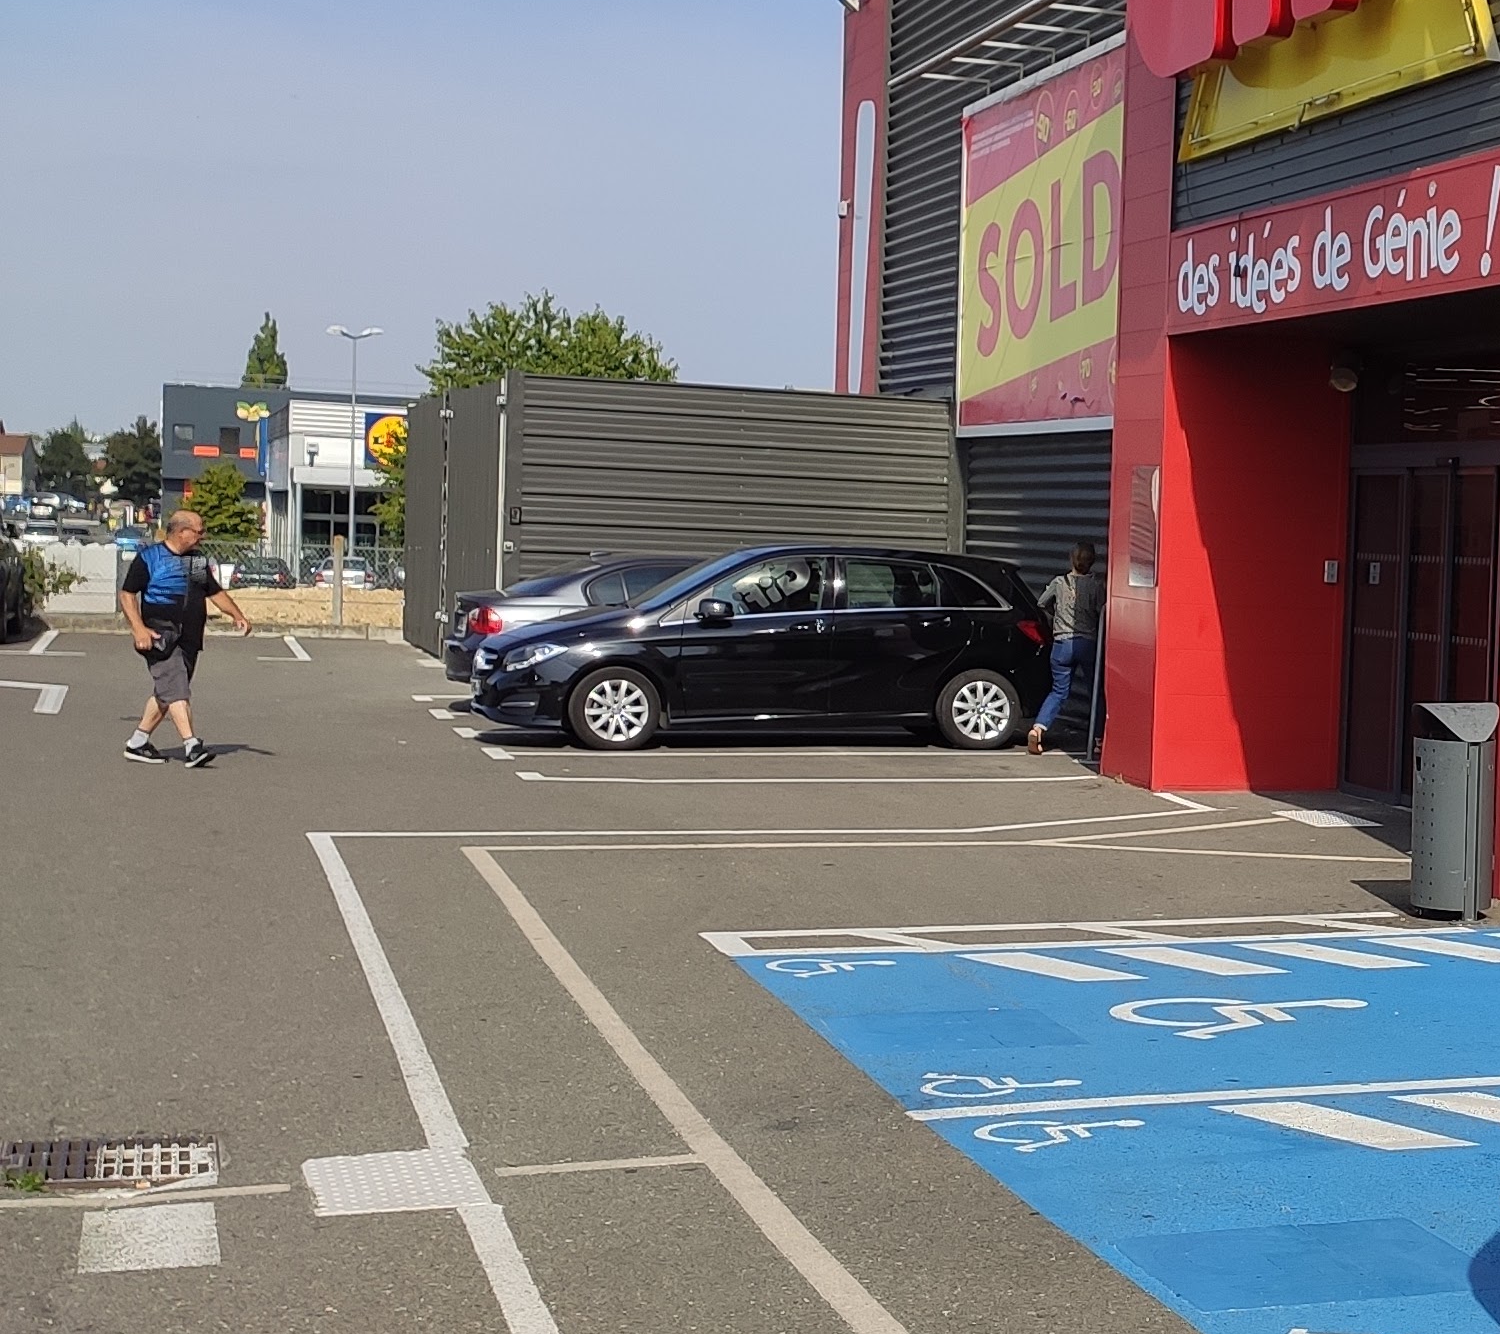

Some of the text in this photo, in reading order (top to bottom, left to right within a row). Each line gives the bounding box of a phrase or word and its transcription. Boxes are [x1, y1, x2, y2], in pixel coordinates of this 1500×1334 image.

[977, 149, 1121, 358] SOLD
[1178, 238, 1220, 315] des
[1228, 220, 1301, 314] idées
[1312, 205, 1351, 291] de
[1364, 180, 1462, 281] Génie
